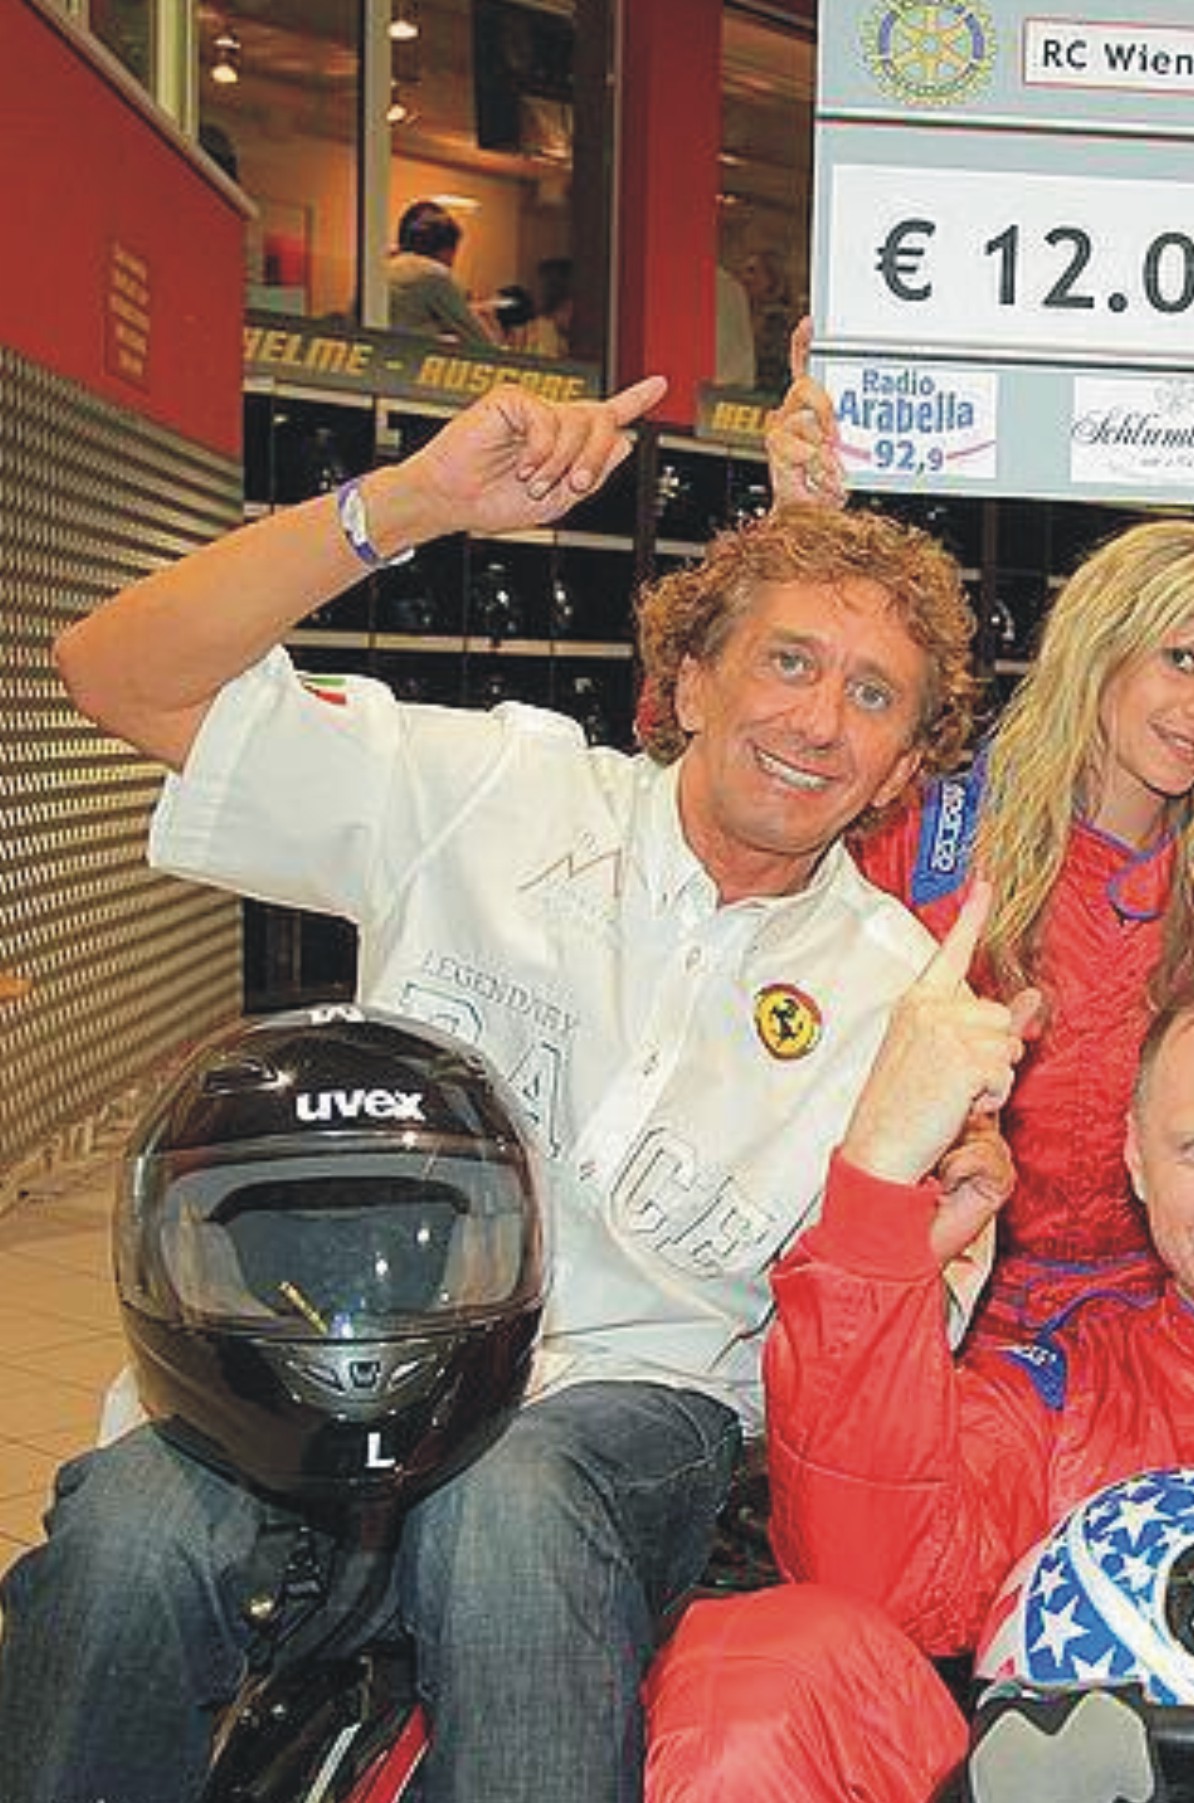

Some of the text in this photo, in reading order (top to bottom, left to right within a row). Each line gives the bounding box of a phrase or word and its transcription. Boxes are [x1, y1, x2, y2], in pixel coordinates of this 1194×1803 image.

[1042, 38, 1088, 69] RC
[1104, 43, 1194, 75] Wien
[874, 217, 937, 302] €
[862, 368, 936, 398] Radio
[837, 387, 975, 434] Arabella
[874, 439, 945, 476] 92,9
[296, 1087, 427, 1123] uvex
[367, 1432, 396, 1468] L
